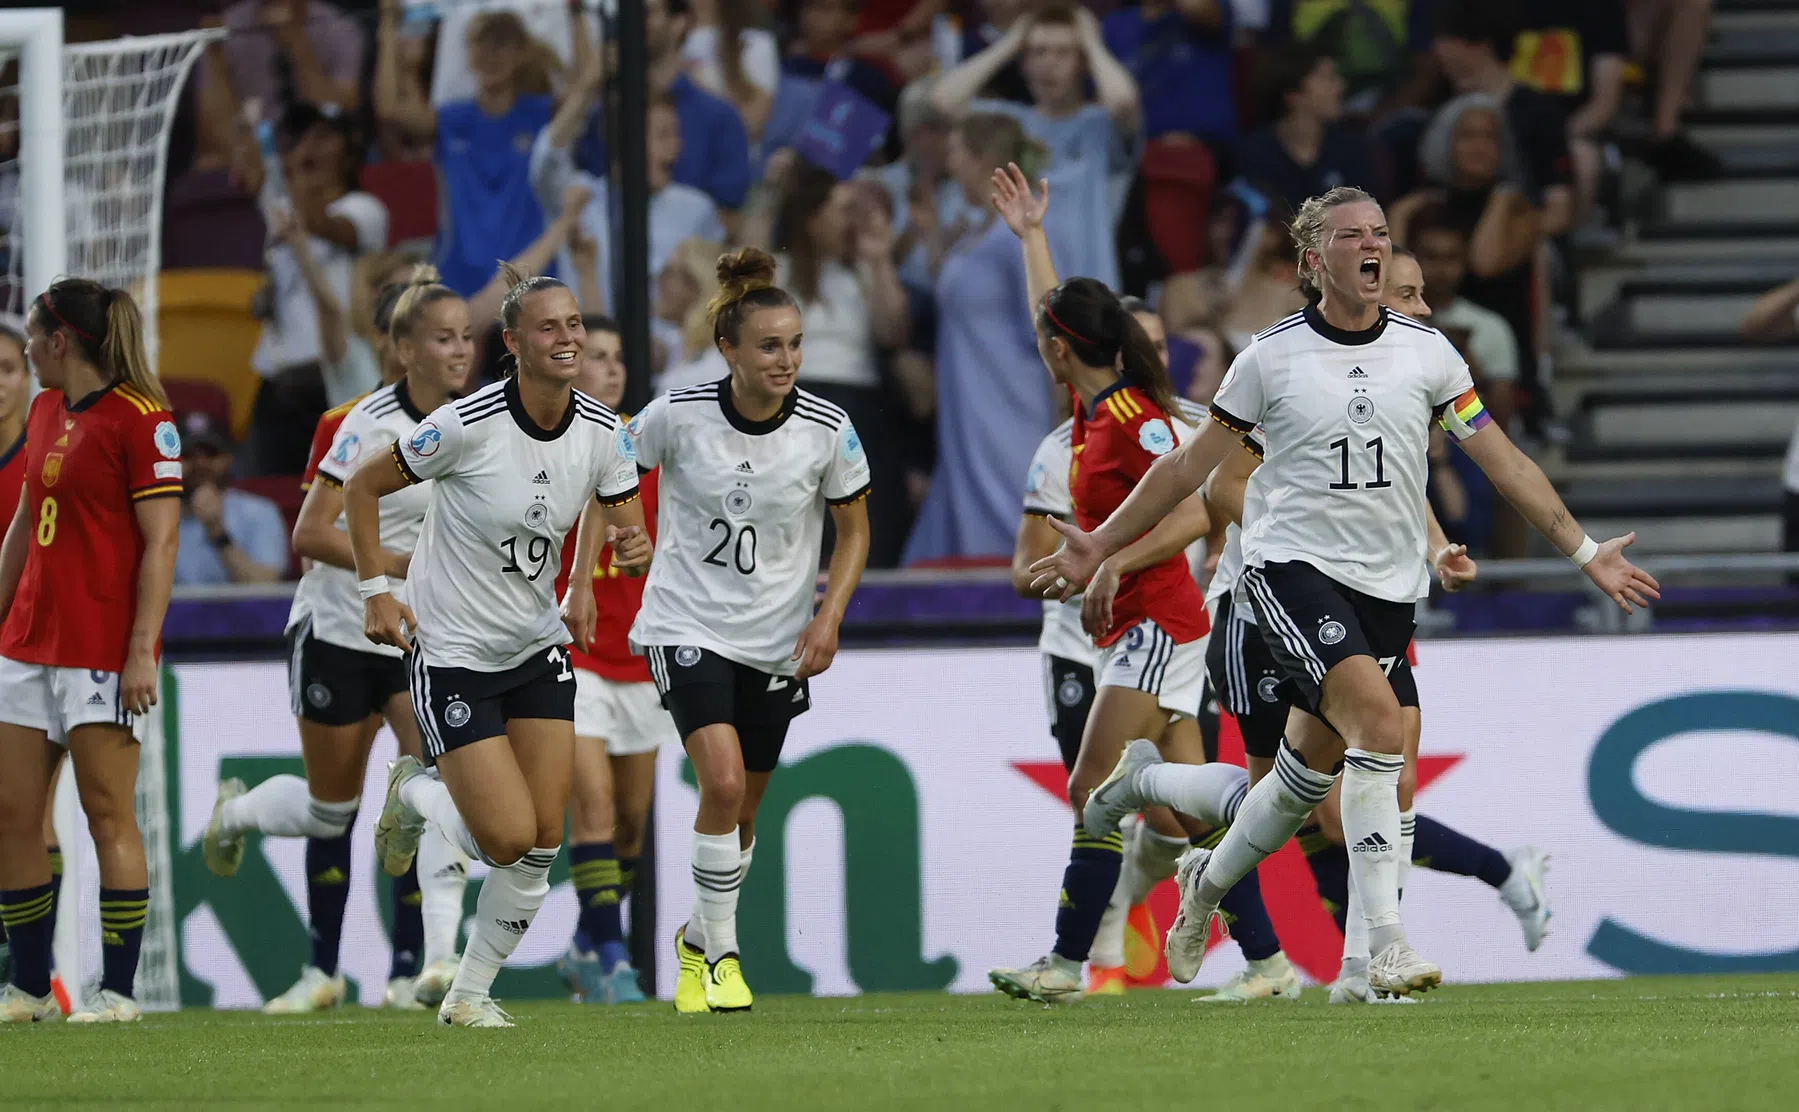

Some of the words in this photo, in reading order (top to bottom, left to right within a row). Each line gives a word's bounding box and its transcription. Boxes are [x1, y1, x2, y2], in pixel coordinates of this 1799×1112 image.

[1329, 436, 1392, 490] 11
[37, 496, 58, 547] 8
[702, 518, 757, 575] 20
[500, 536, 551, 581] 19
[1352, 844, 1393, 853] adidas
[1586, 689, 1799, 976] S
